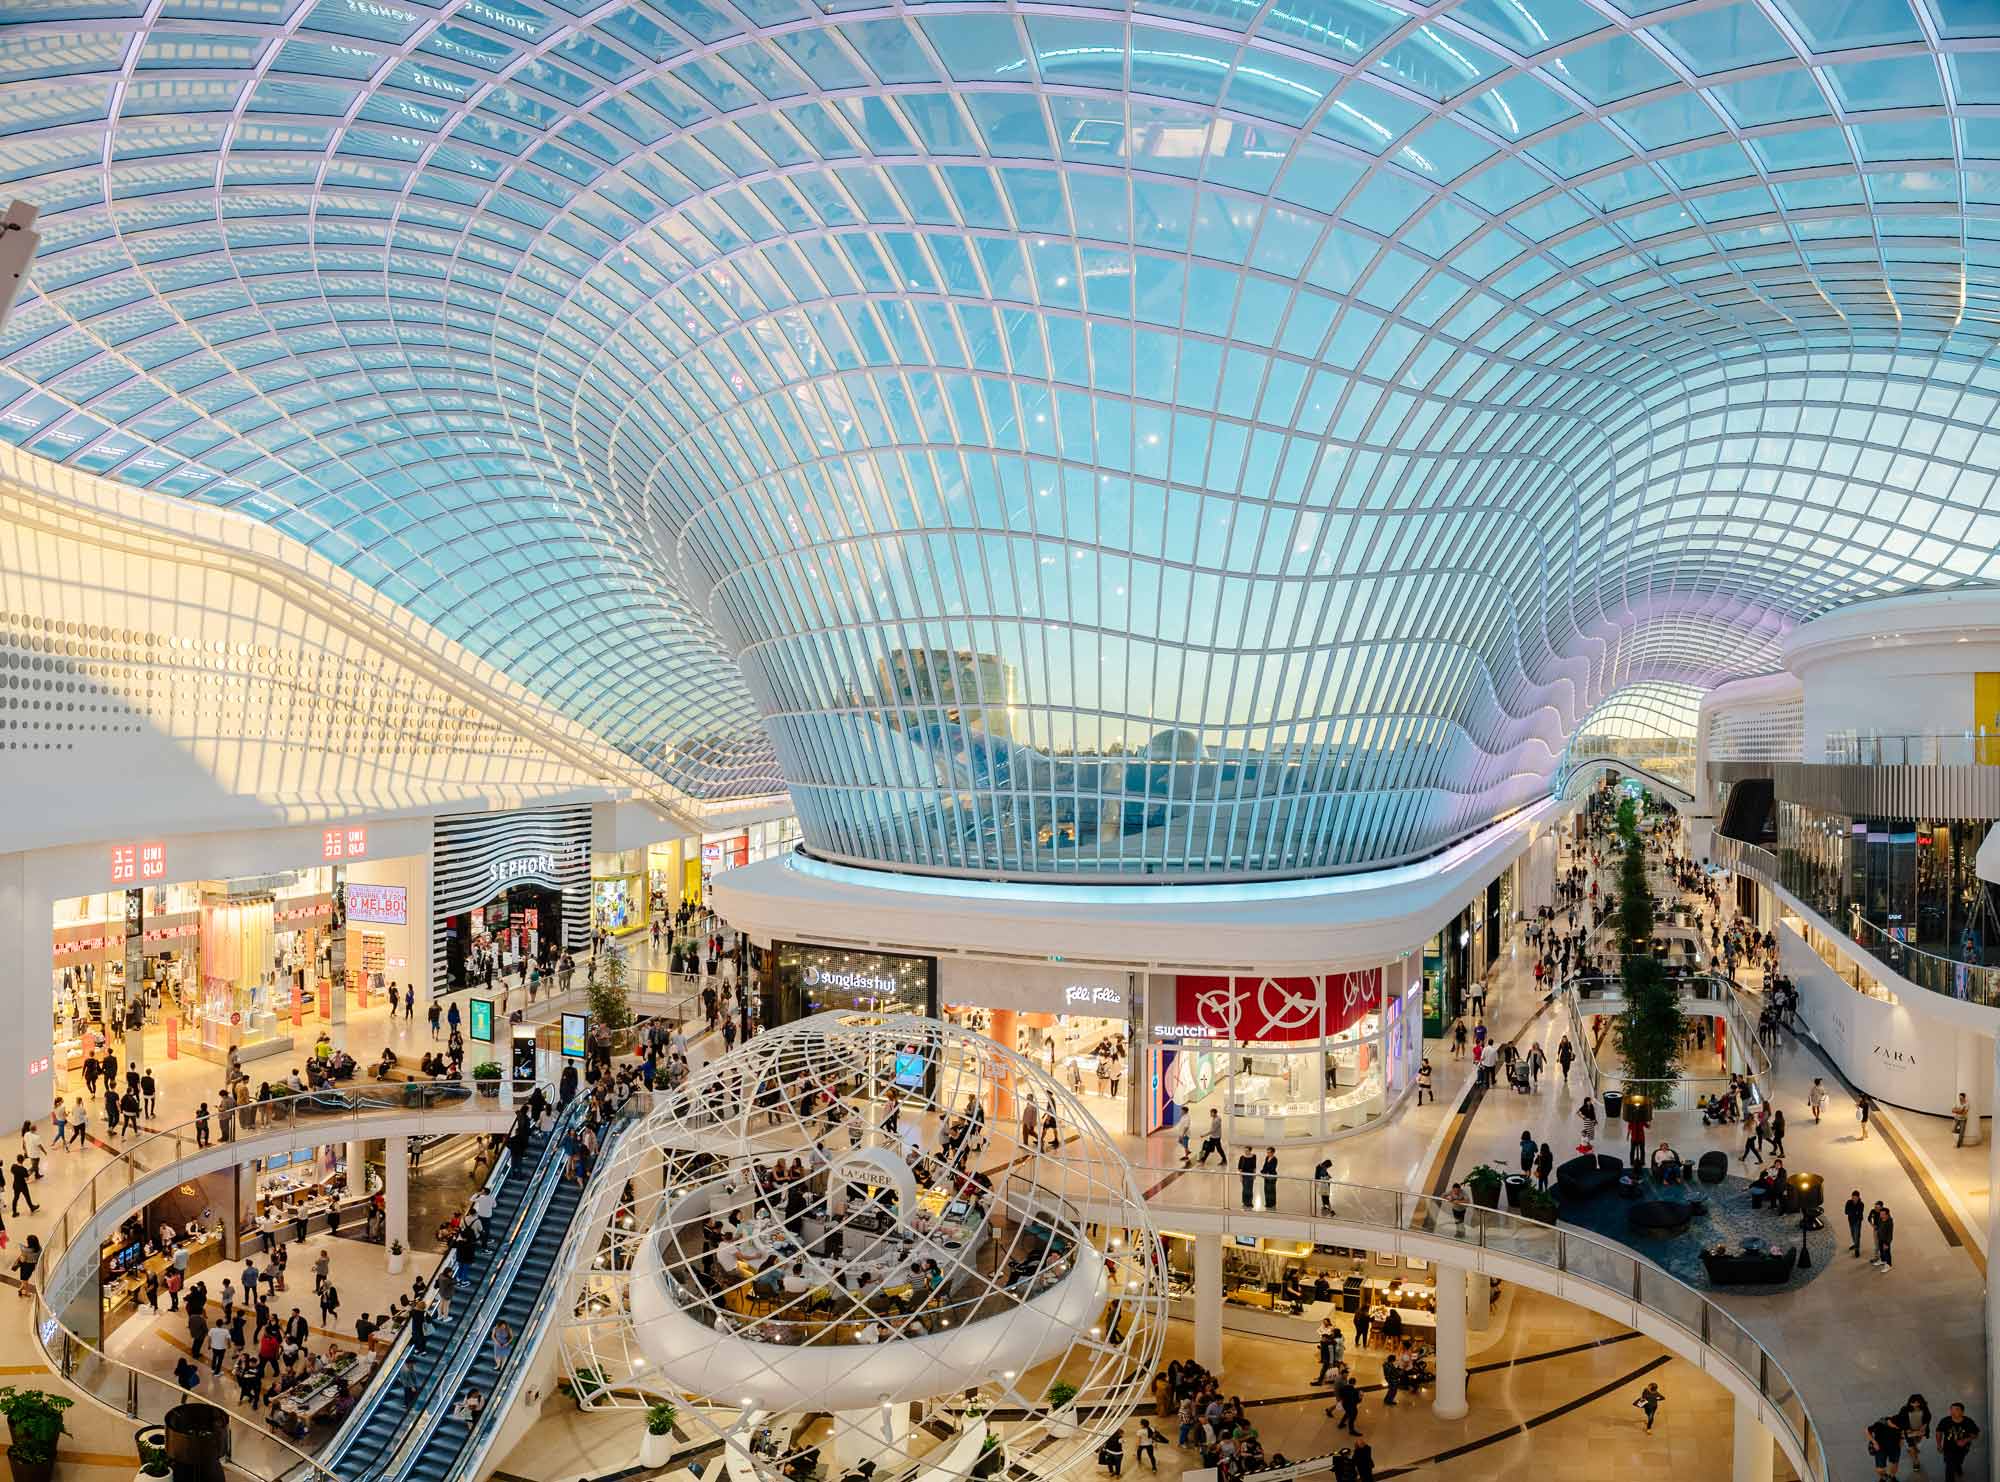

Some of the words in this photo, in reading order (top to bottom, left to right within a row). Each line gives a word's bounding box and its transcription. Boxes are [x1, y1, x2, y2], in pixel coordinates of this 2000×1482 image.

[348, 831, 363, 842] UNI
[143, 847, 162, 860] UNI
[348, 843, 365, 855] QLO
[143, 862, 164, 877] QLO
[489, 855, 555, 881] SEPHORA
[821, 972, 874, 990] sunglass
[875, 975, 897, 992] hut
[1065, 985, 1090, 1006] Folli
[1092, 987, 1121, 1004] Follie
[1154, 1025, 1208, 1037] swatch
[1873, 1046, 1917, 1065] ZARA
